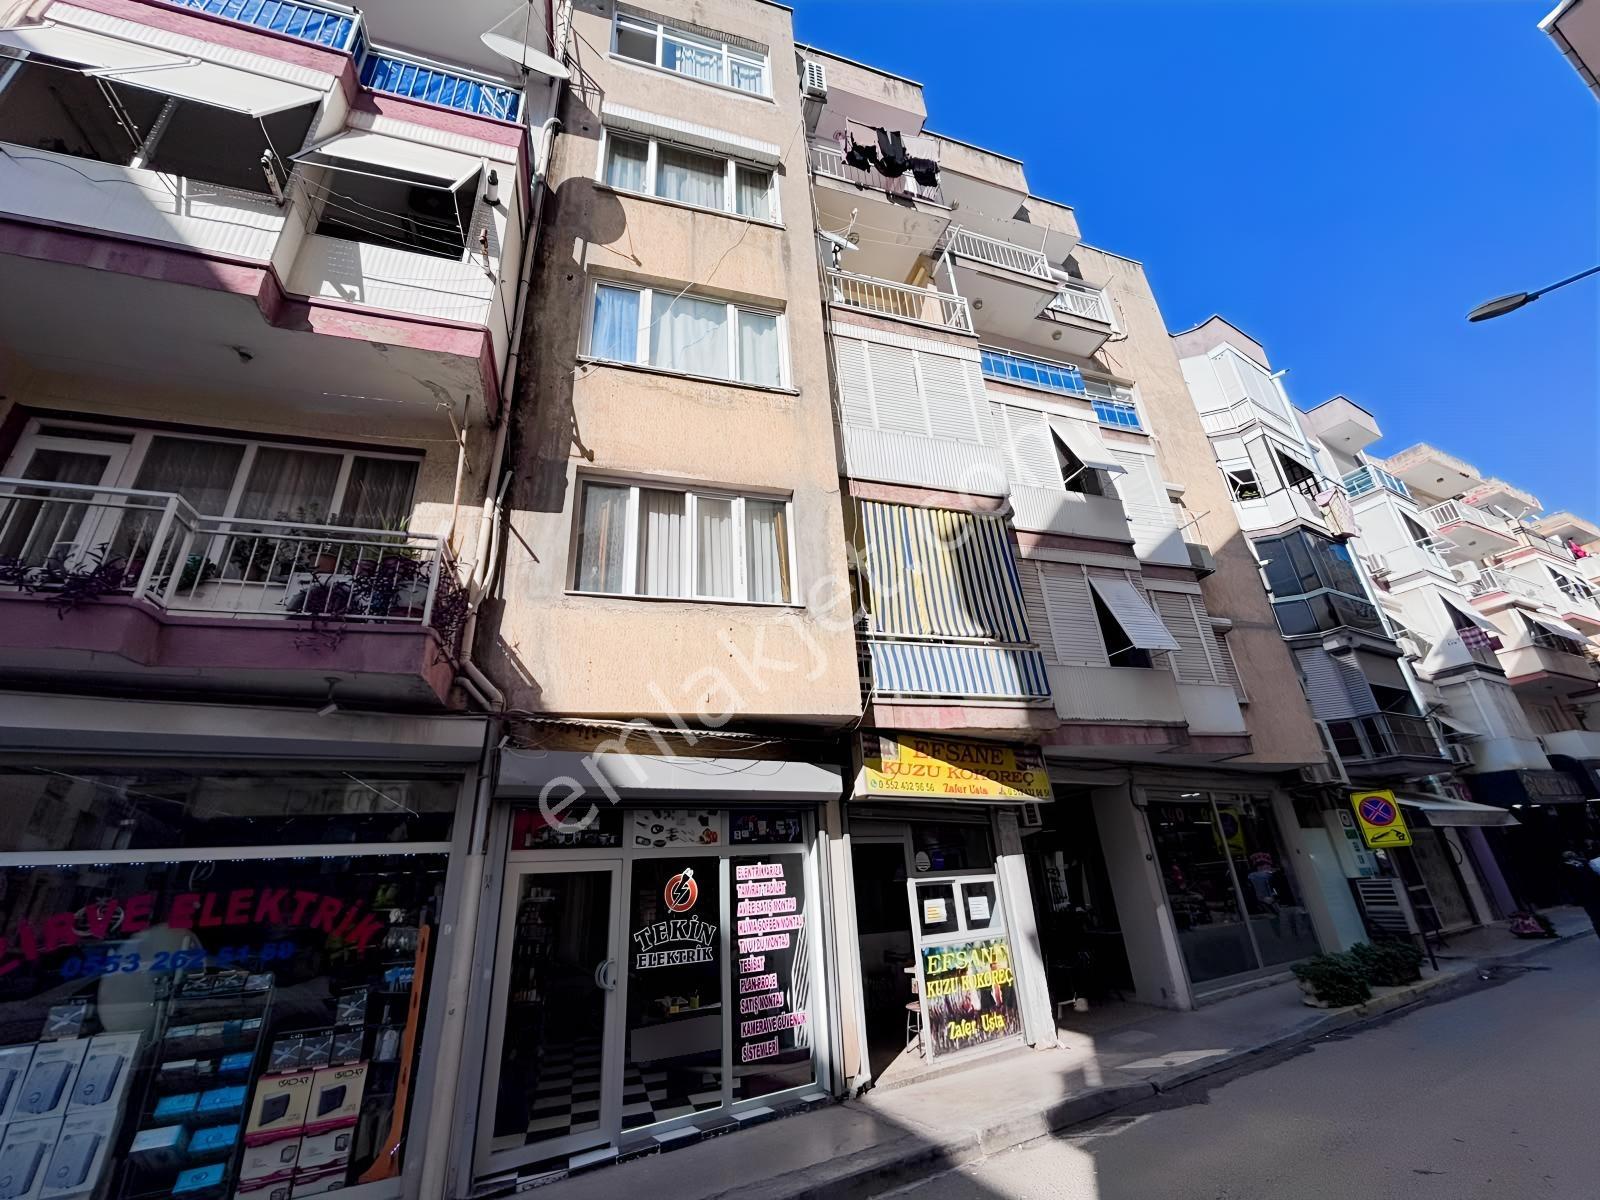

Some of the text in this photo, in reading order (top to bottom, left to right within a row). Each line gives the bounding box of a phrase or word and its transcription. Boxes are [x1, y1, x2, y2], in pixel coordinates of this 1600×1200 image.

[912, 739, 1004, 766] EFSANE
[883, 761, 1035, 787] KUZU KOKOREÇ
[942, 782, 989, 795] Zafer Usta
[169, 887, 384, 958] ELEKTRİK
[633, 914, 717, 951] TEKİN
[59, 952, 141, 979] 0553
[636, 944, 713, 969] ELEKTRİK
[739, 954, 766, 973] TESİSAT
[926, 944, 1009, 975] EFSANE
[926, 967, 1014, 999] KUZU KOKOREÇ
[740, 991, 784, 1014] SATIŞ MONTAJ
[741, 1018, 768, 1037] KAMERA
[981, 1010, 1005, 1032] Usta
[742, 1036, 779, 1062] SİSTEMLERİ
